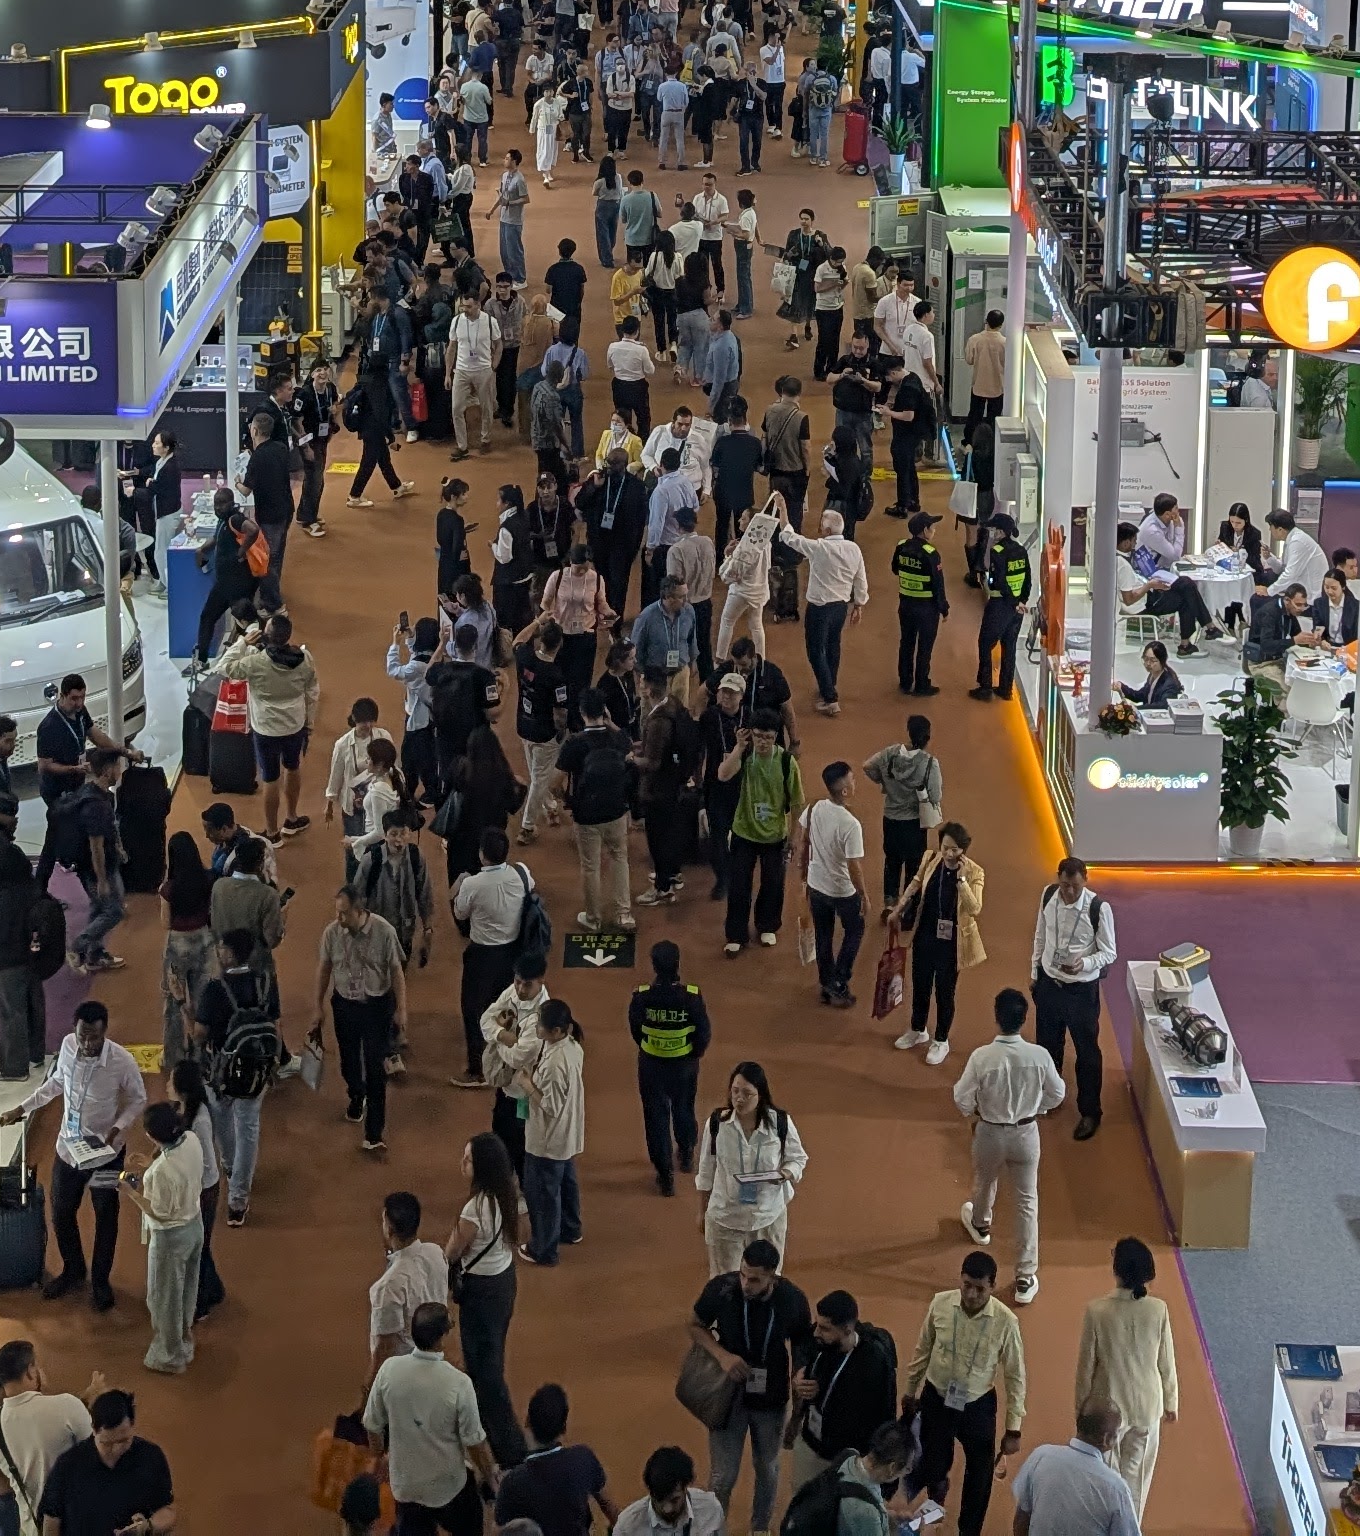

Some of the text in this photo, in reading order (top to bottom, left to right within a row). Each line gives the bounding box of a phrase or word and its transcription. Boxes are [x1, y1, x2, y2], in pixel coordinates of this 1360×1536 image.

[6, 365, 97, 384] LIMITED
[1136, 379, 1171, 387] Solution
[1140, 388, 1168, 397] System
